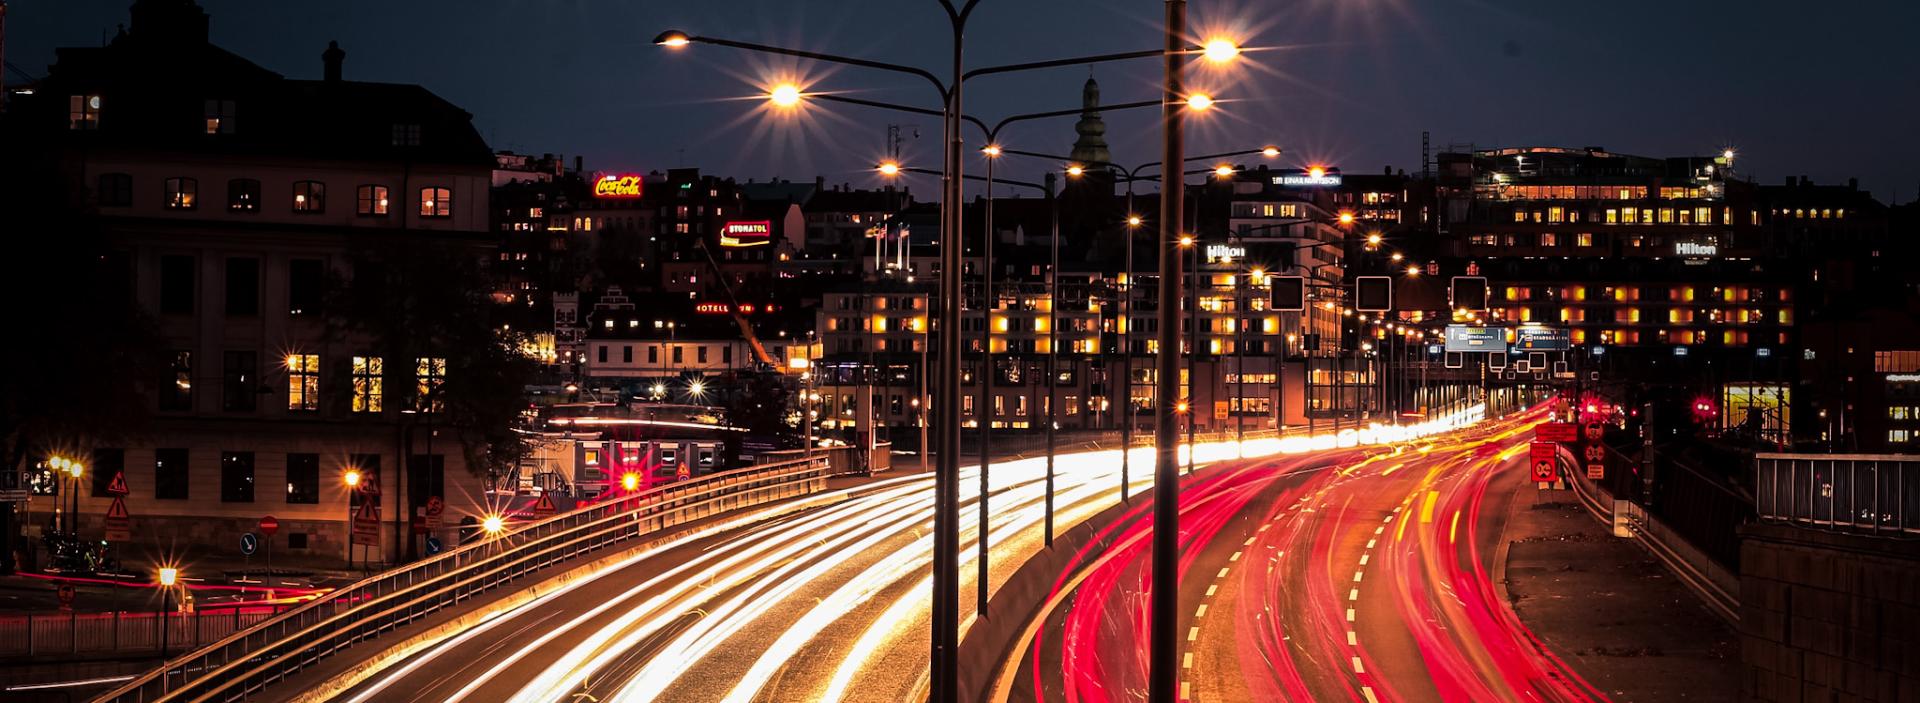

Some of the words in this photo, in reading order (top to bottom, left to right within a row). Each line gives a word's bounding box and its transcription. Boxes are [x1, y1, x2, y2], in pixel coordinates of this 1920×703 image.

[596, 176, 641, 196] Coca-Cola
[729, 224, 767, 233] STOMATOL
[1207, 244, 1245, 257] Hilton
[1676, 242, 1716, 255] Hilton
